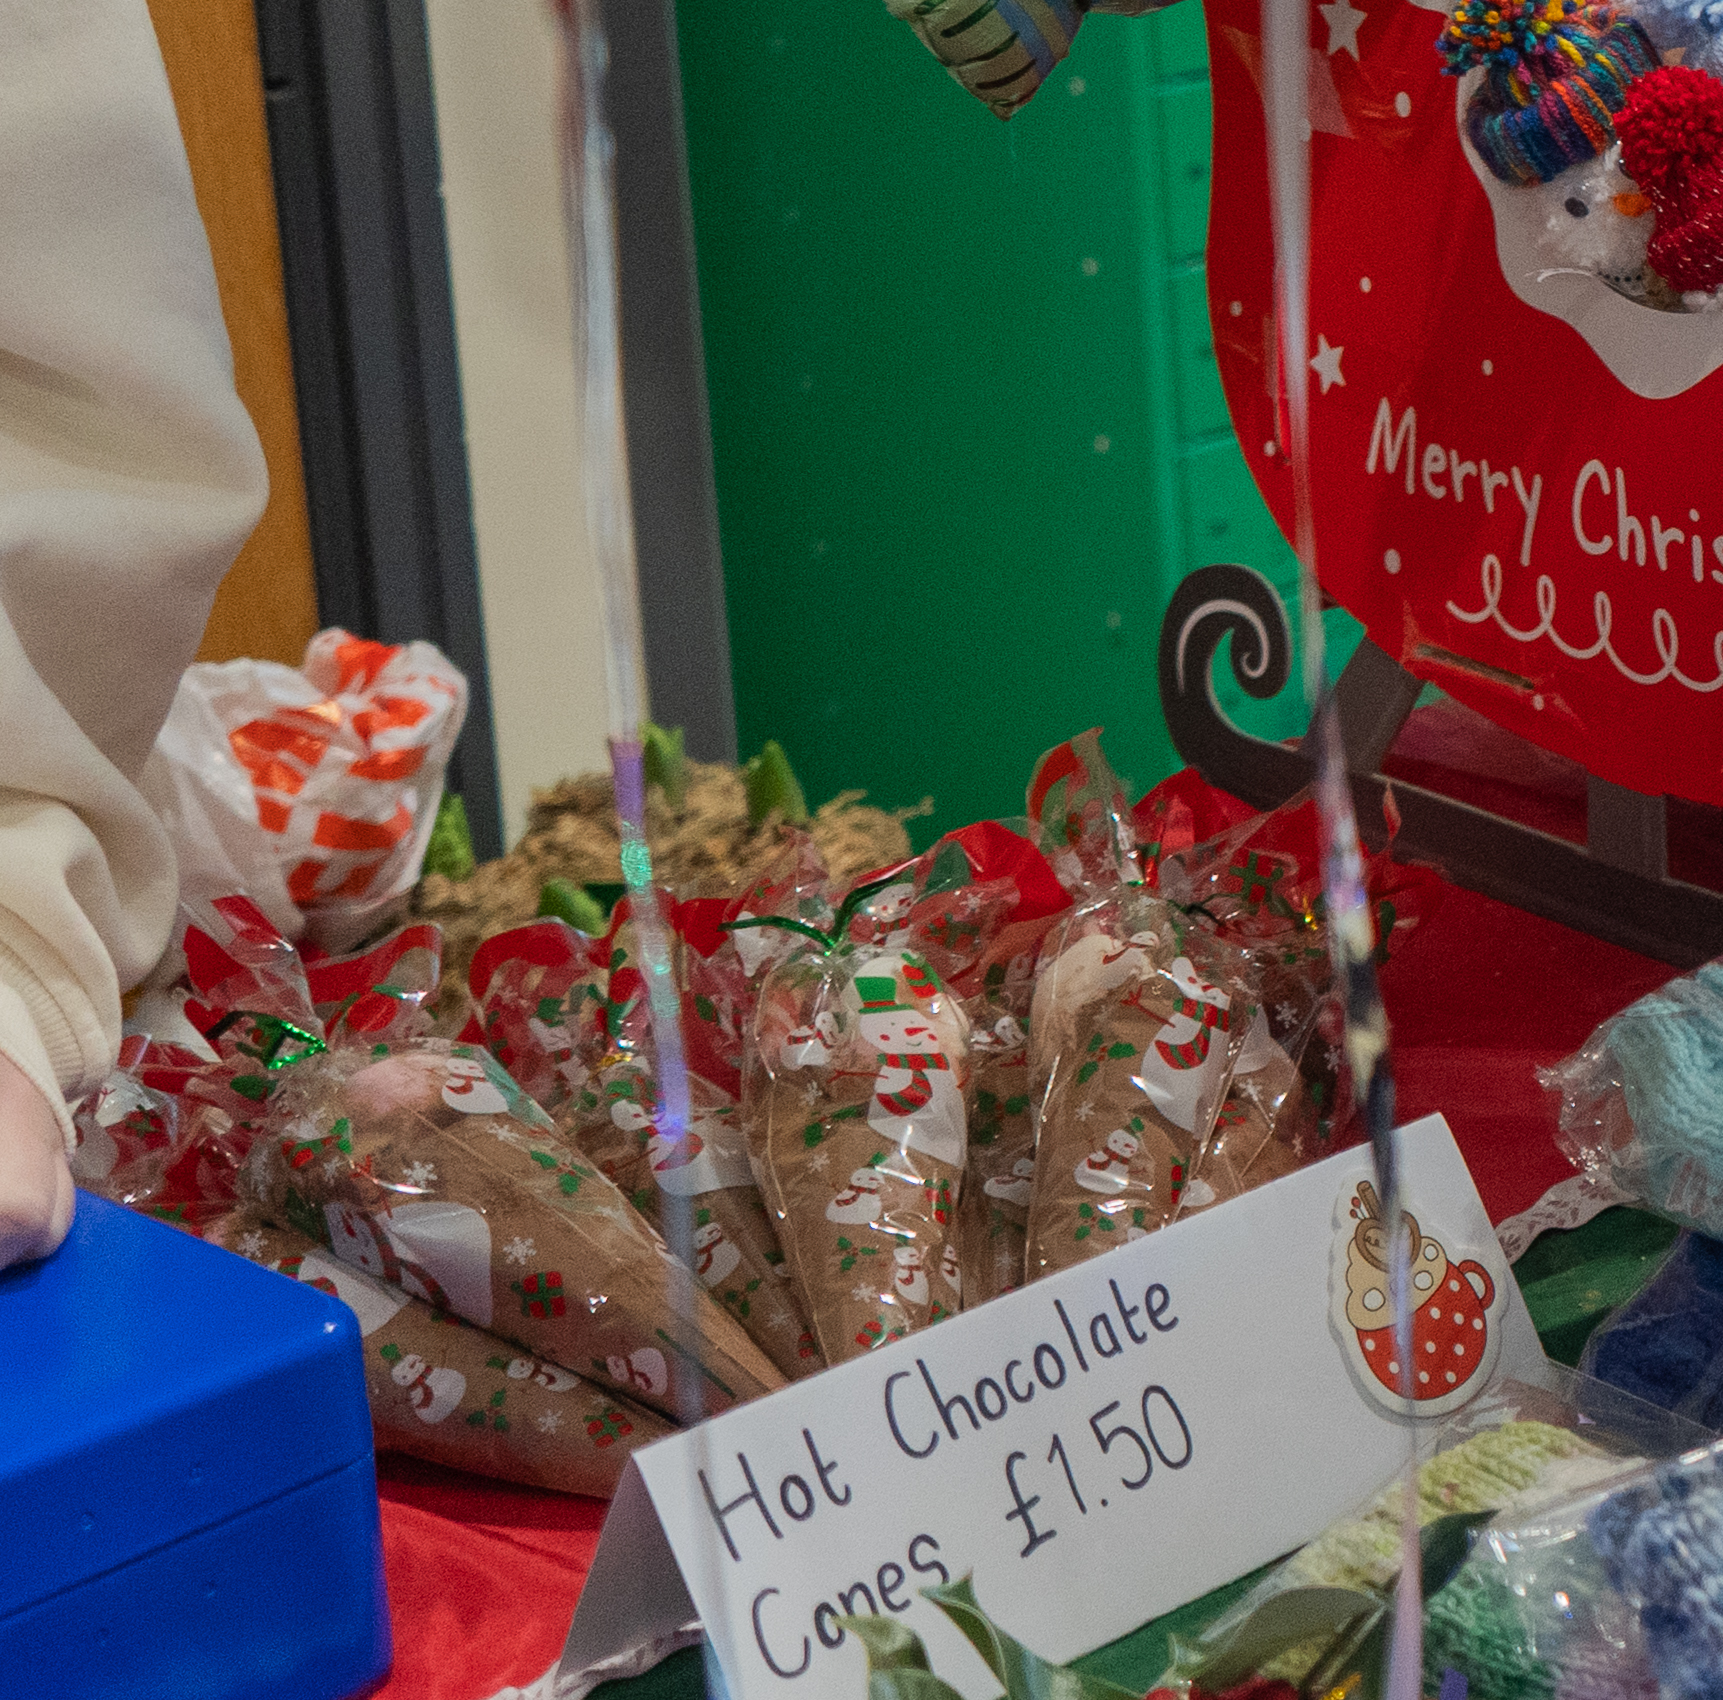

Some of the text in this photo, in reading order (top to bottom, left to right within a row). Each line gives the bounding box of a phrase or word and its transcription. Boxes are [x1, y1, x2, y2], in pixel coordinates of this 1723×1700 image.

[1365, 396, 1543, 567] Merry
[697, 1277, 1181, 1563] Hot Chocolate
[1003, 1384, 1195, 1560] £1.50
